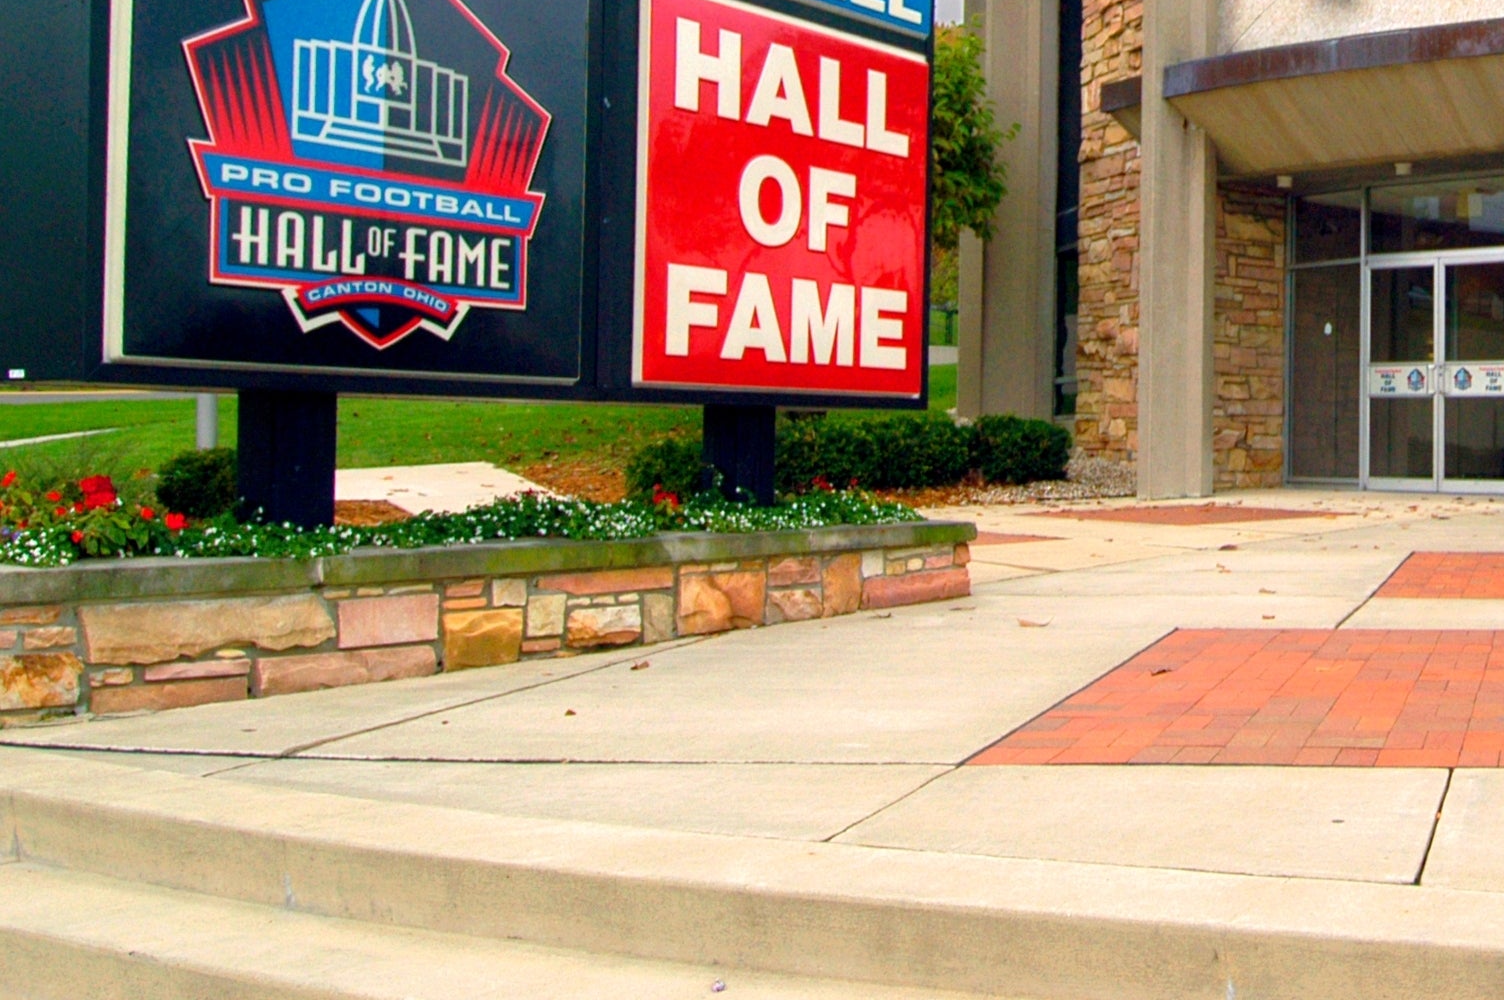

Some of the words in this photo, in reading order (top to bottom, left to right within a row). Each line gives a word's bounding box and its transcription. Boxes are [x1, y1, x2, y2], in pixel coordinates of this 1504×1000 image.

[674, 17, 909, 158] HALL
[221, 163, 312, 193] PRO
[329, 179, 521, 223] FOOTBALL
[738, 154, 857, 253] OF
[232, 205, 366, 275] HALL
[367, 226, 396, 258] OF
[398, 227, 511, 289] FAME
[307, 280, 393, 302] CANTON
[402, 287, 449, 314] OHIO
[664, 262, 908, 370] FAME
